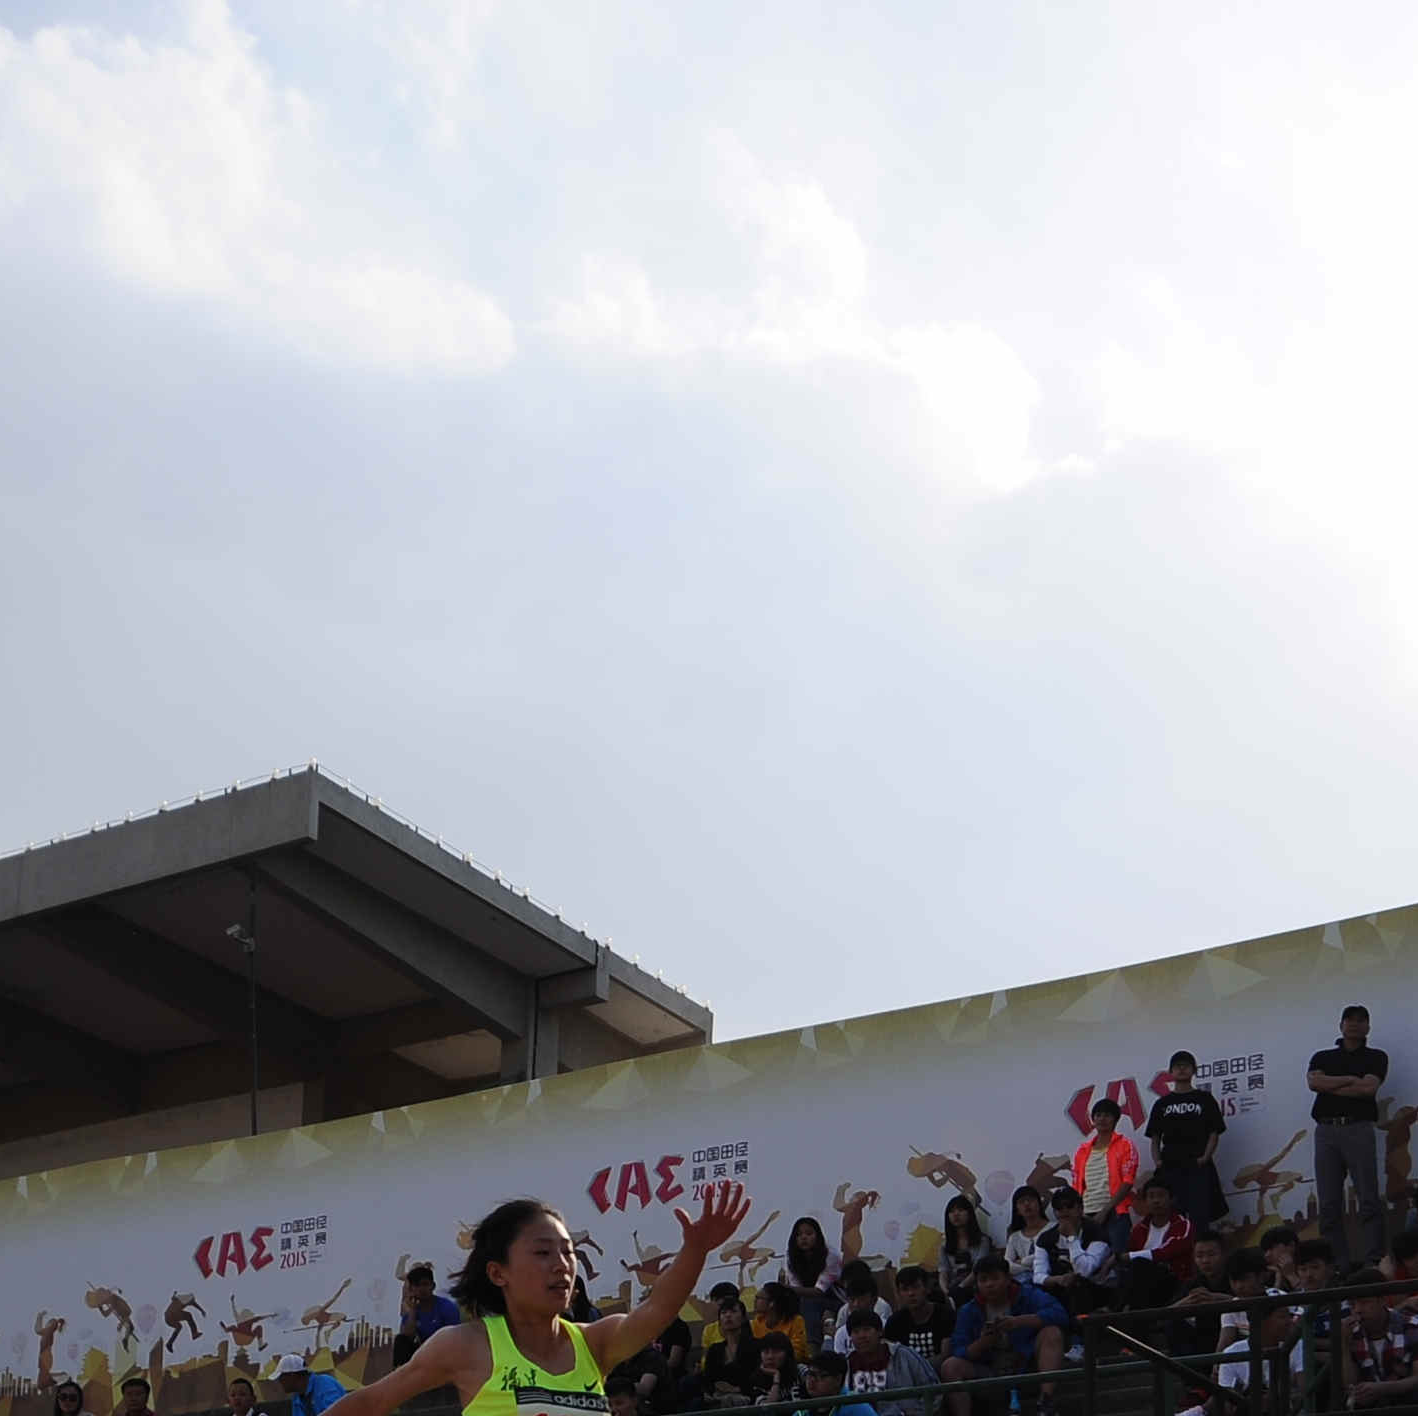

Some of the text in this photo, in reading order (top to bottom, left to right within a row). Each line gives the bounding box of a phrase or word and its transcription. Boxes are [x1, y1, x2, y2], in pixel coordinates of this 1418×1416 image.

[1196, 1054, 1265, 1079] 中国田径
[693, 1142, 748, 1163] 中国田径
[281, 1215, 327, 1234] 中国田径
[280, 1251, 307, 1269] 2015
[553, 1394, 606, 1410] adidas
